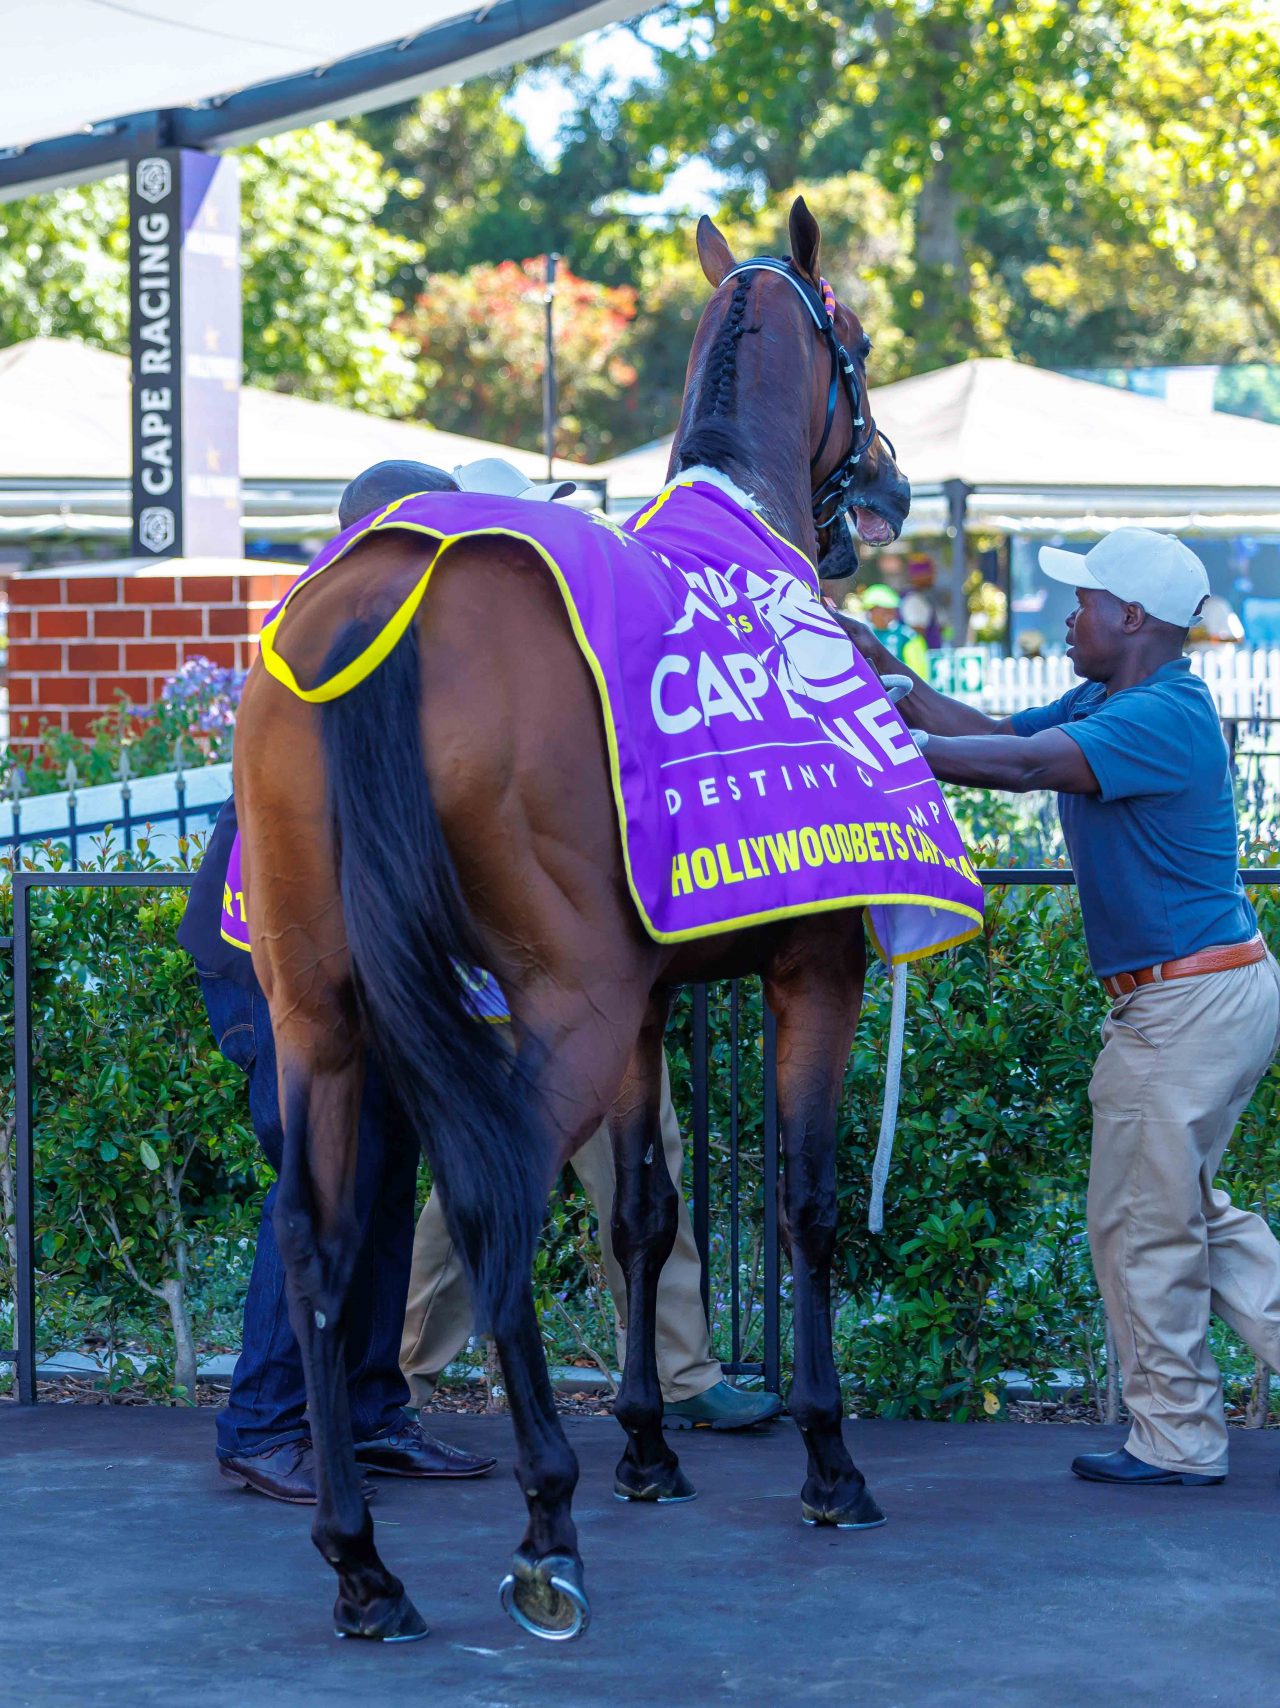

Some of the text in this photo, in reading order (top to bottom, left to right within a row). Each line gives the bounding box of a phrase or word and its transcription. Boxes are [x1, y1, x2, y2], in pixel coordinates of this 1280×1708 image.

[137, 212, 174, 496] CAPE RACING
[650, 650, 770, 735] CAP
[664, 762, 838, 816] DESTINY
[671, 821, 910, 897] HOLLYWOODBETS
